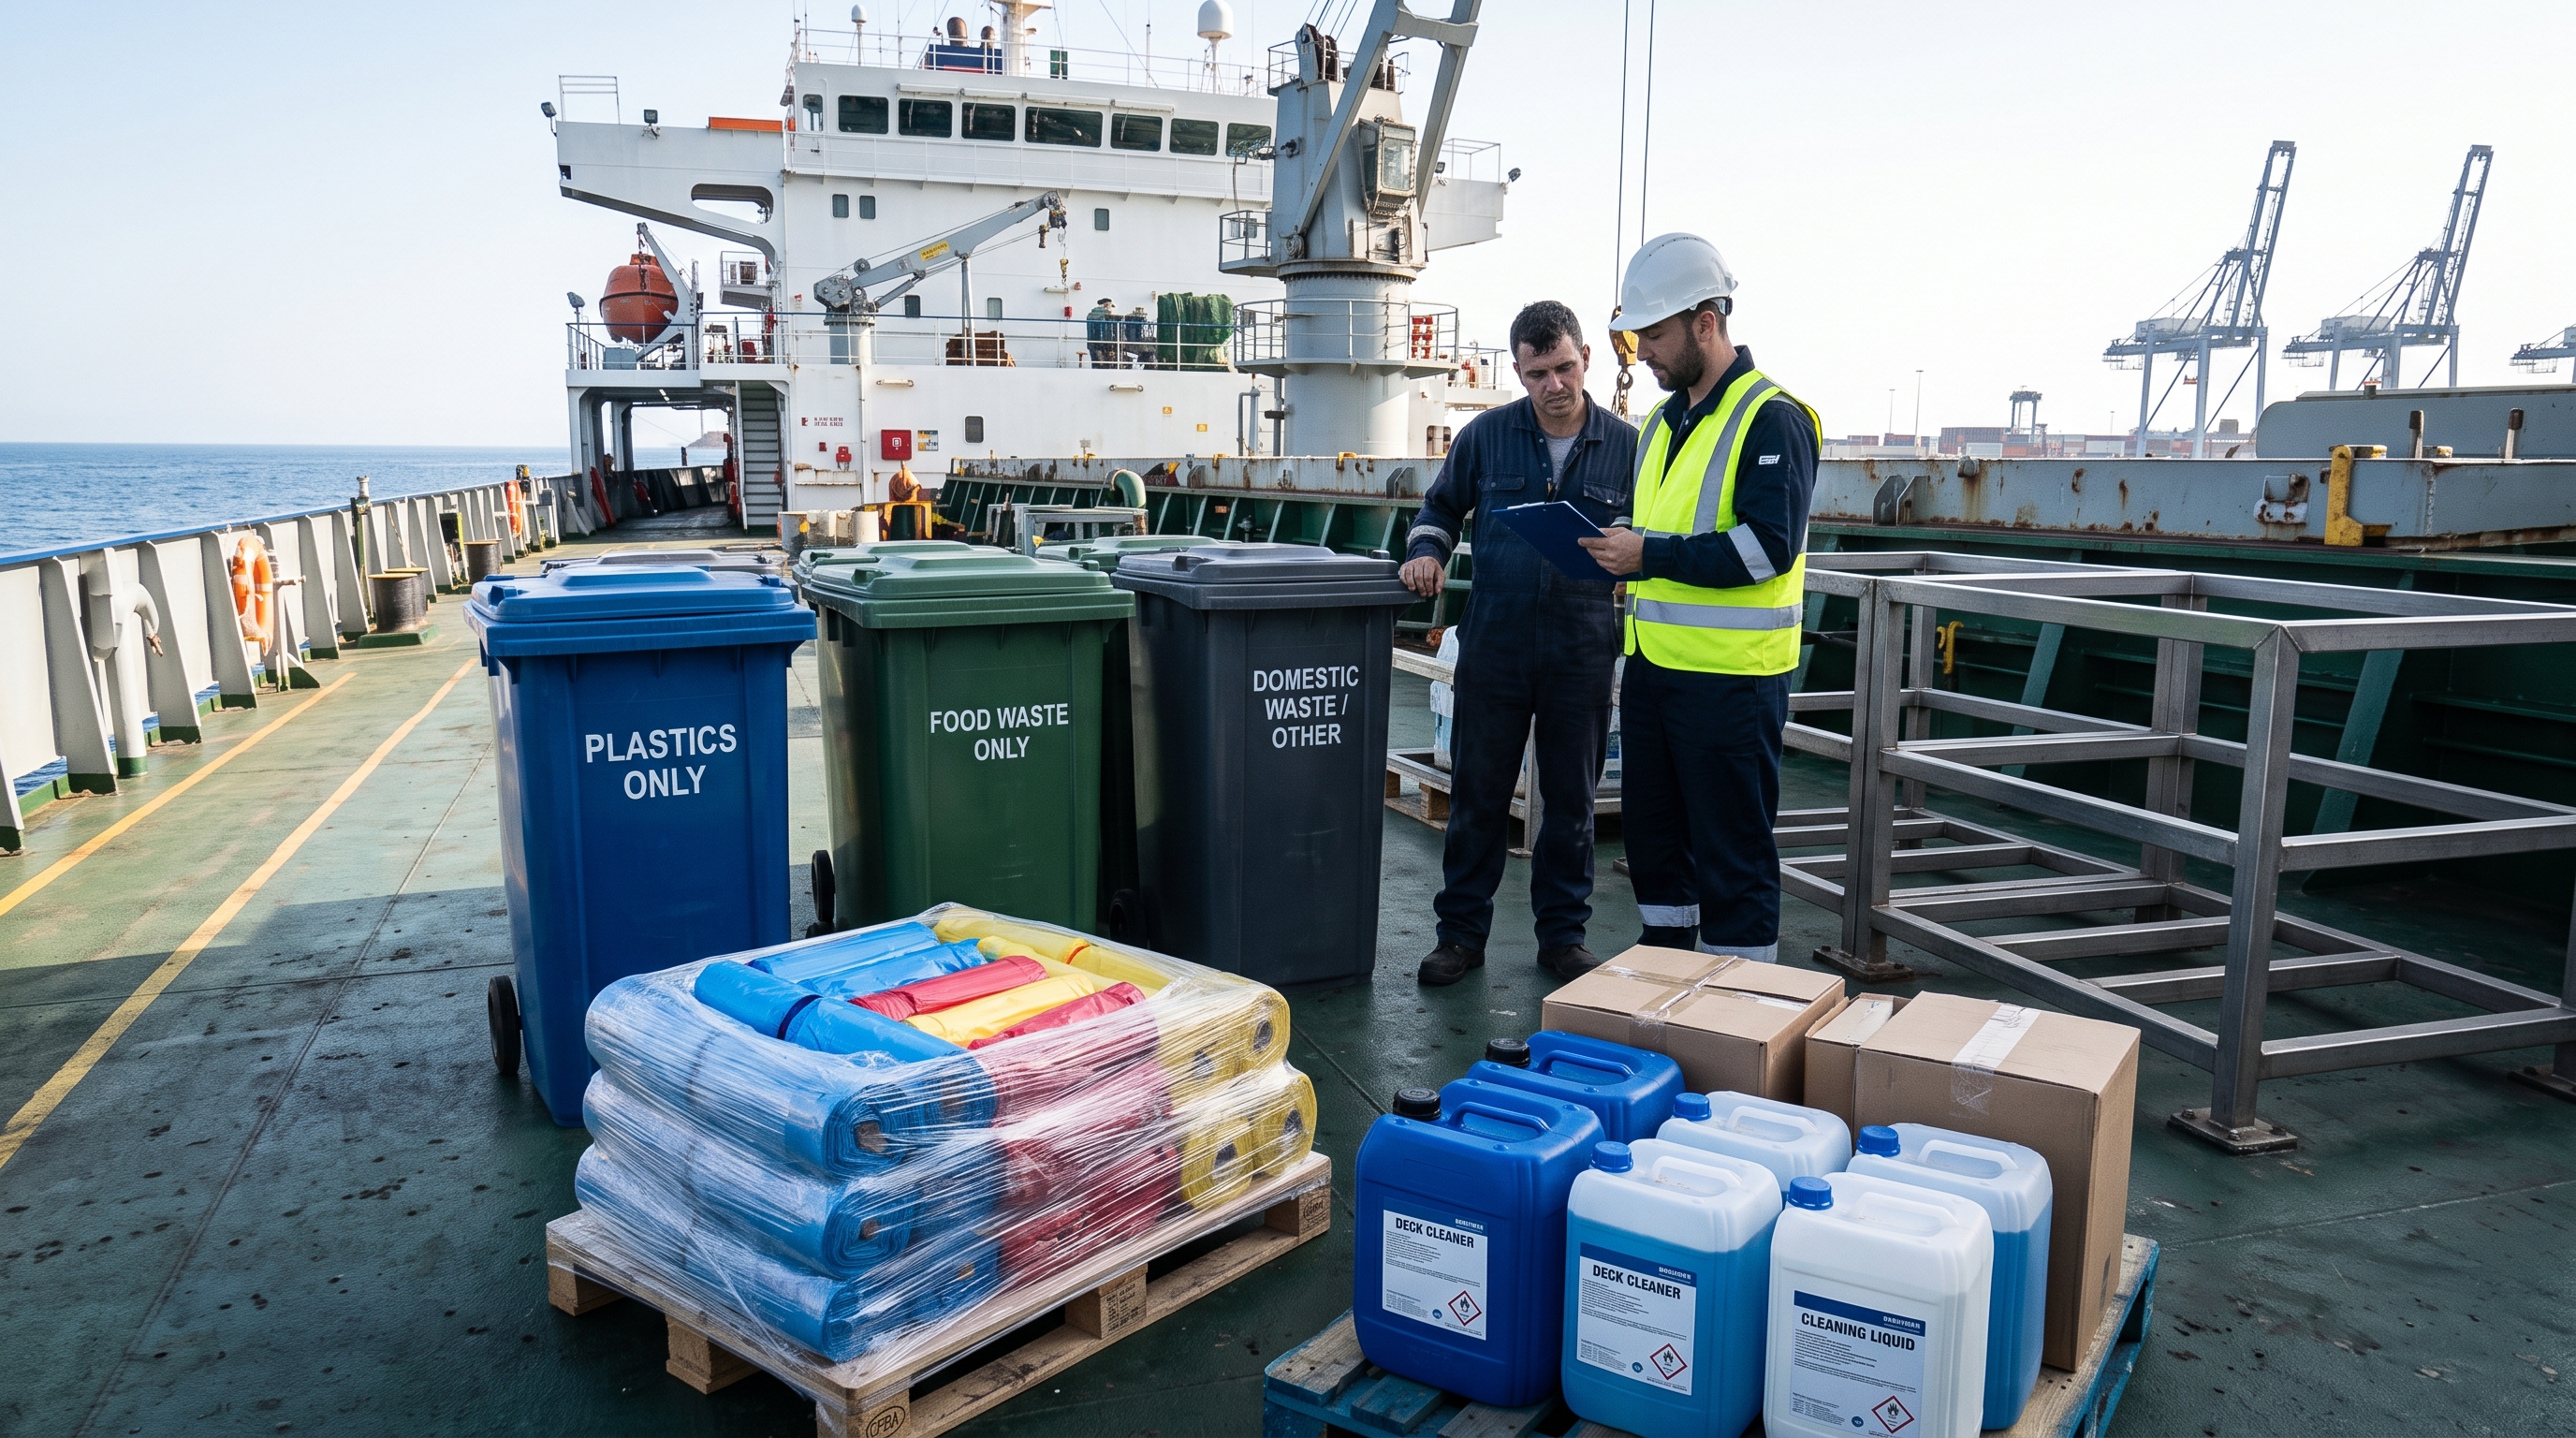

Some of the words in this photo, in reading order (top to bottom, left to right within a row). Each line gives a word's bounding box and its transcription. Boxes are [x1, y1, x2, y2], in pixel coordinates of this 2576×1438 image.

[1253, 666, 1359, 692] DOMESTIC
[930, 709, 991, 734] FOOD
[997, 703, 1069, 729] WASTE
[1265, 695, 1337, 720] WASTE
[1341, 694, 1348, 715] /
[585, 724, 738, 763] PLASTICS
[973, 736, 1031, 761] ONLY
[1272, 723, 1341, 749] OTHER
[623, 765, 707, 800] ONLY
[1396, 1217, 1423, 1235] DECK
[1427, 1225, 1474, 1248] CLEANER
[1592, 1264, 1624, 1284] DECK
[1627, 1274, 1681, 1299] CLEANER
[1801, 1313, 1866, 1340] CLEANING
[1870, 1329, 1915, 1351] LIQUID
